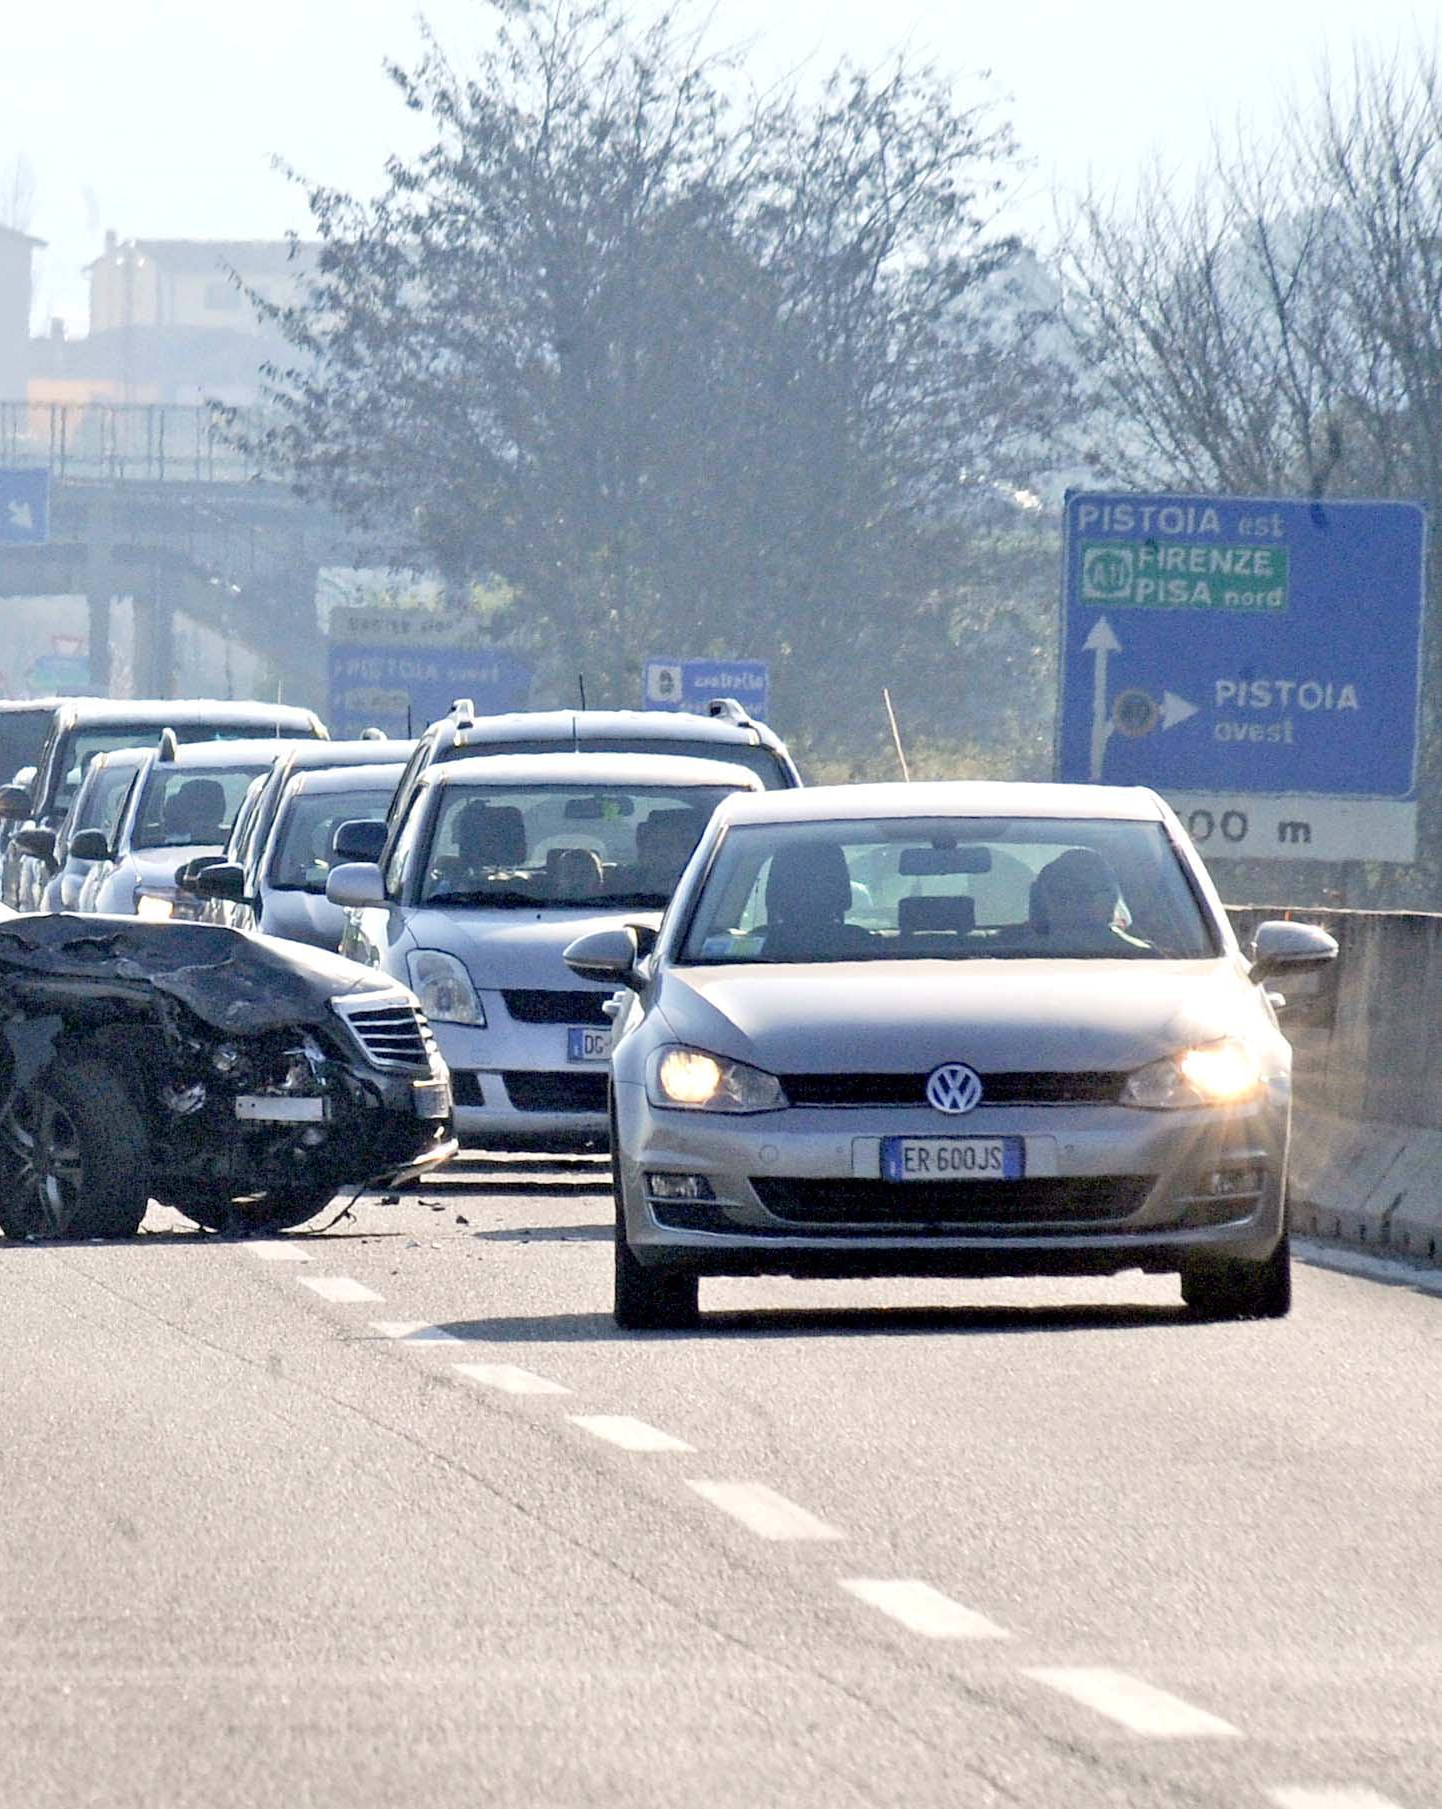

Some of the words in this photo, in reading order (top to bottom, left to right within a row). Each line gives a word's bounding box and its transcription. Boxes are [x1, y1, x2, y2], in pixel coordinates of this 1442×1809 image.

[1078, 504, 1221, 534] PISTOIA
[1238, 512, 1285, 537] est
[1138, 547, 1273, 576] FIRENZE
[1136, 578, 1212, 604] PISA
[1224, 587, 1283, 606] nord
[1214, 680, 1358, 710] PISTOIA
[1214, 720, 1294, 744] ovest
[1175, 808, 1248, 842] 00
[1278, 821, 1312, 843] m
